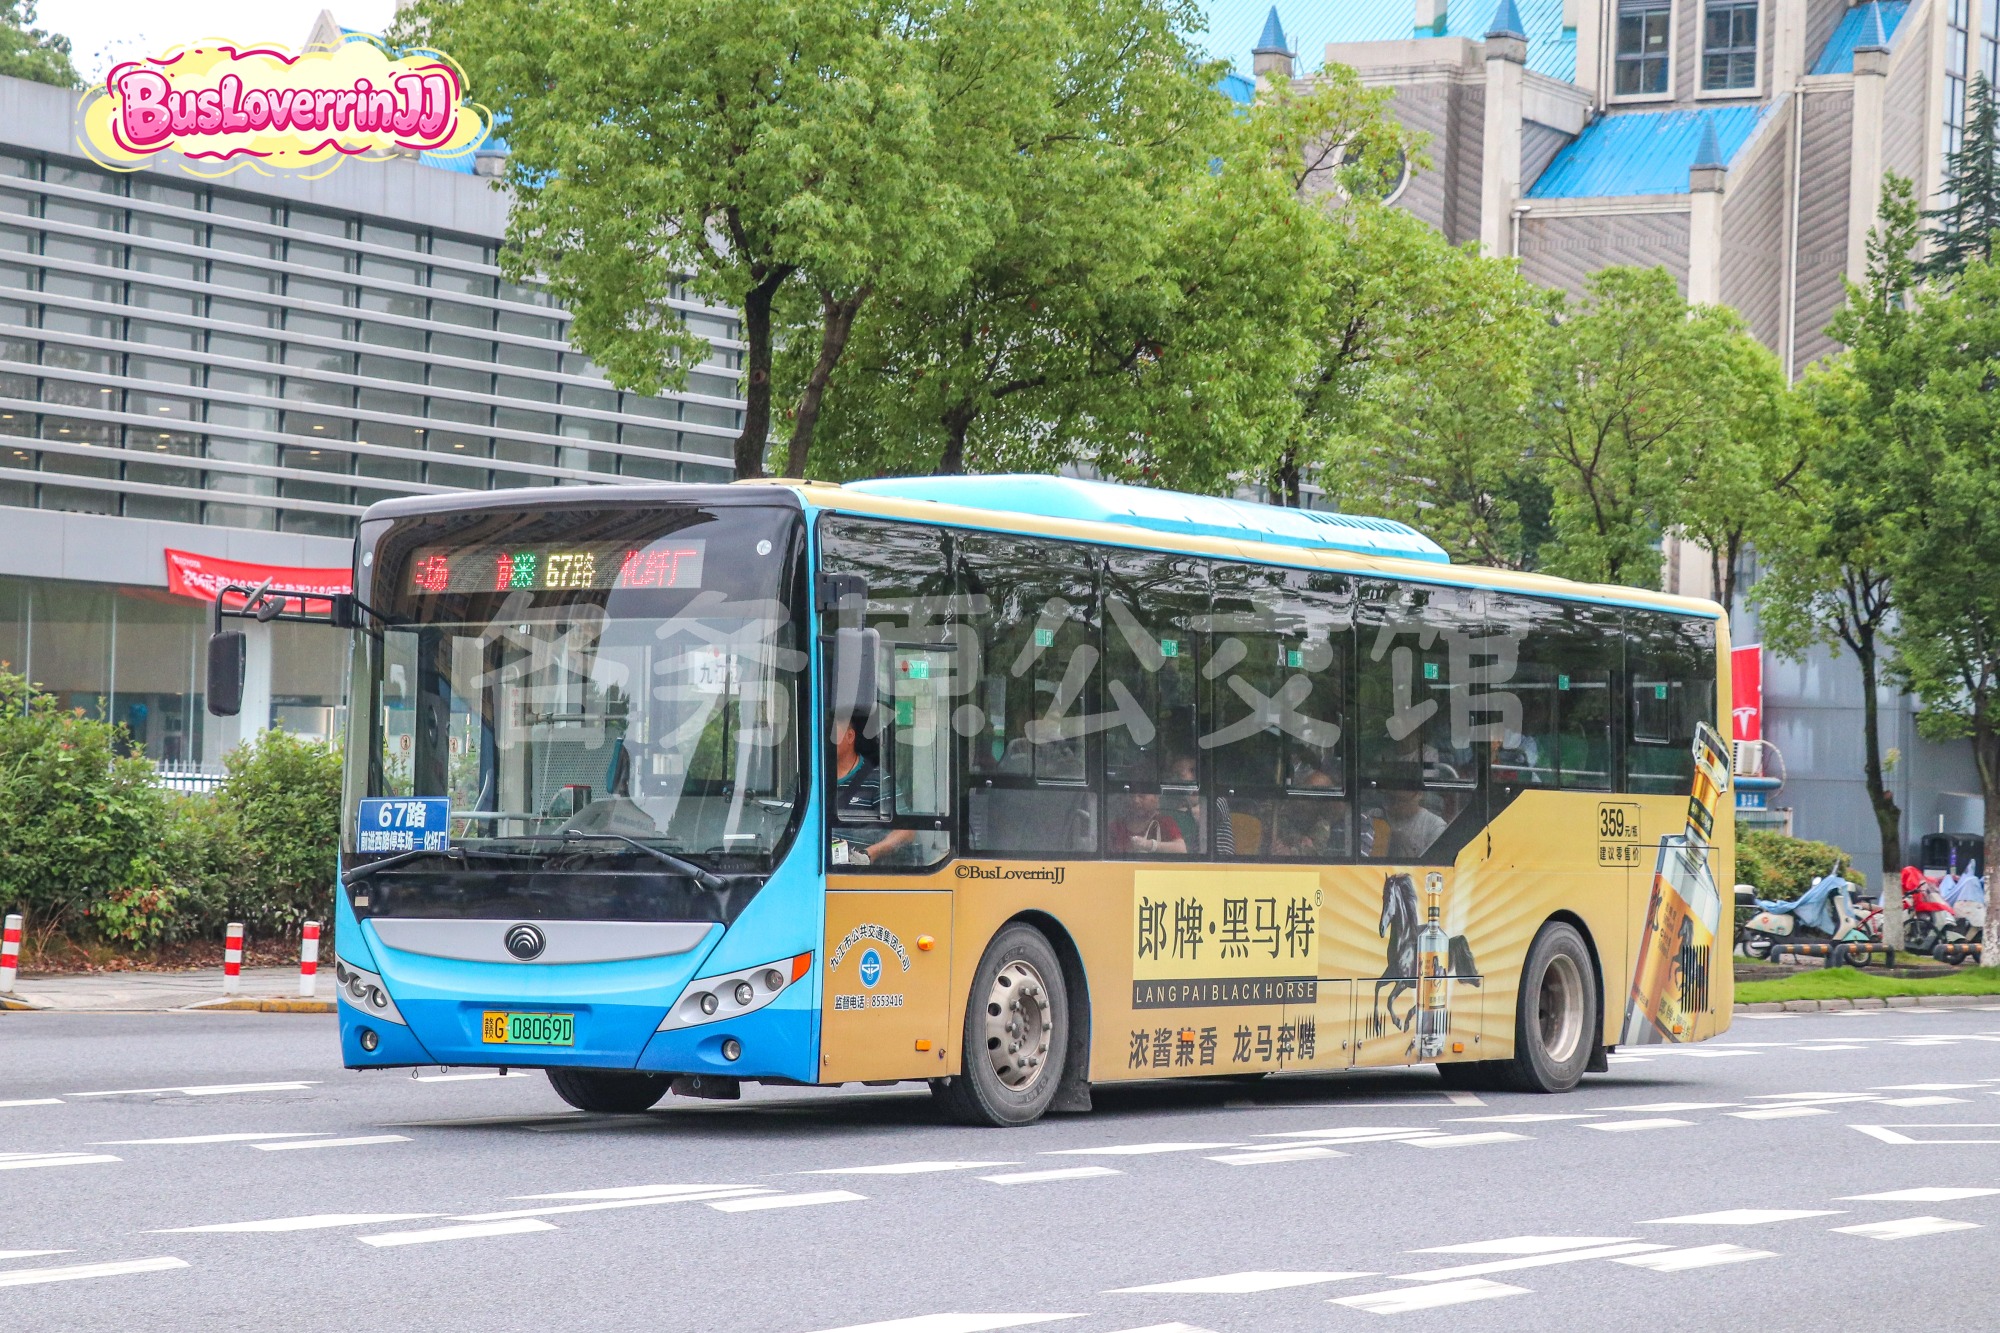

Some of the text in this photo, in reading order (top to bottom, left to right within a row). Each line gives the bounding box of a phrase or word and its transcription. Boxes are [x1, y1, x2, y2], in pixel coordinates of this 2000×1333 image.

[545, 551, 596, 589] 67路
[620, 549, 698, 588] 化纤厂
[378, 801, 427, 828] 67路
[1600, 846, 1640, 862] 建议零售价
[830, 923, 911, 972] 九江市公共交通集团公司
[1136, 985, 1177, 1003] LANG
[1265, 983, 1315, 998] HORSE
[512, 1018, 572, 1041] 08069D
[1128, 1026, 1218, 1070] 浓酱兼香
